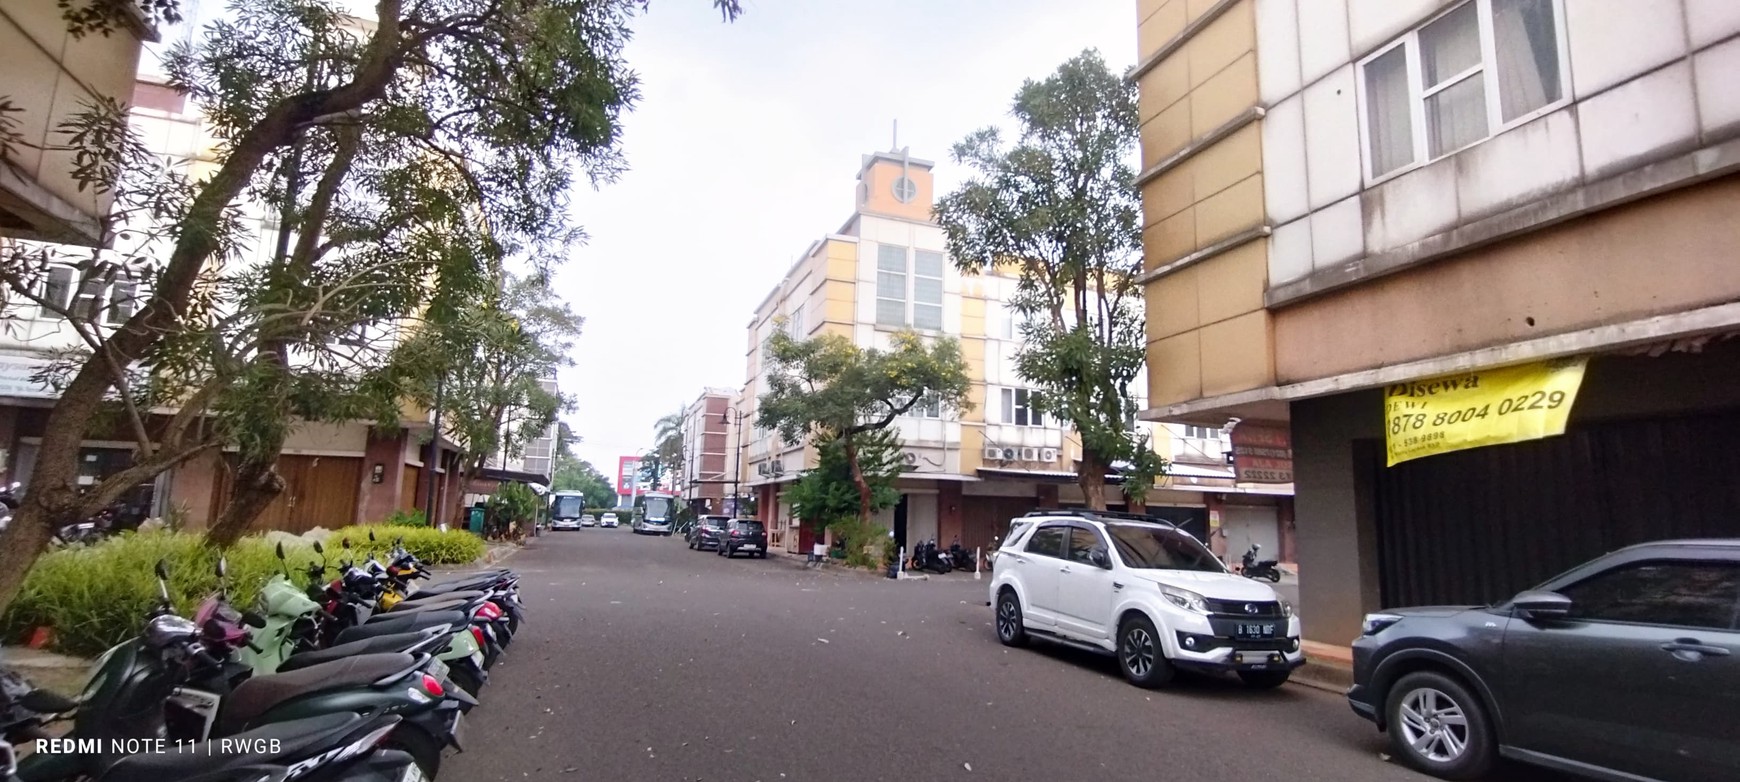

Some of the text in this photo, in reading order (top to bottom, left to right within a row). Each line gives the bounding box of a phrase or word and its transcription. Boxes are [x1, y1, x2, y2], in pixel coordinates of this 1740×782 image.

[1389, 374, 1480, 397] Disewa
[1432, 404, 1491, 427] 8004
[1497, 390, 1566, 416] 0229
[1238, 624, 1243, 634] B
